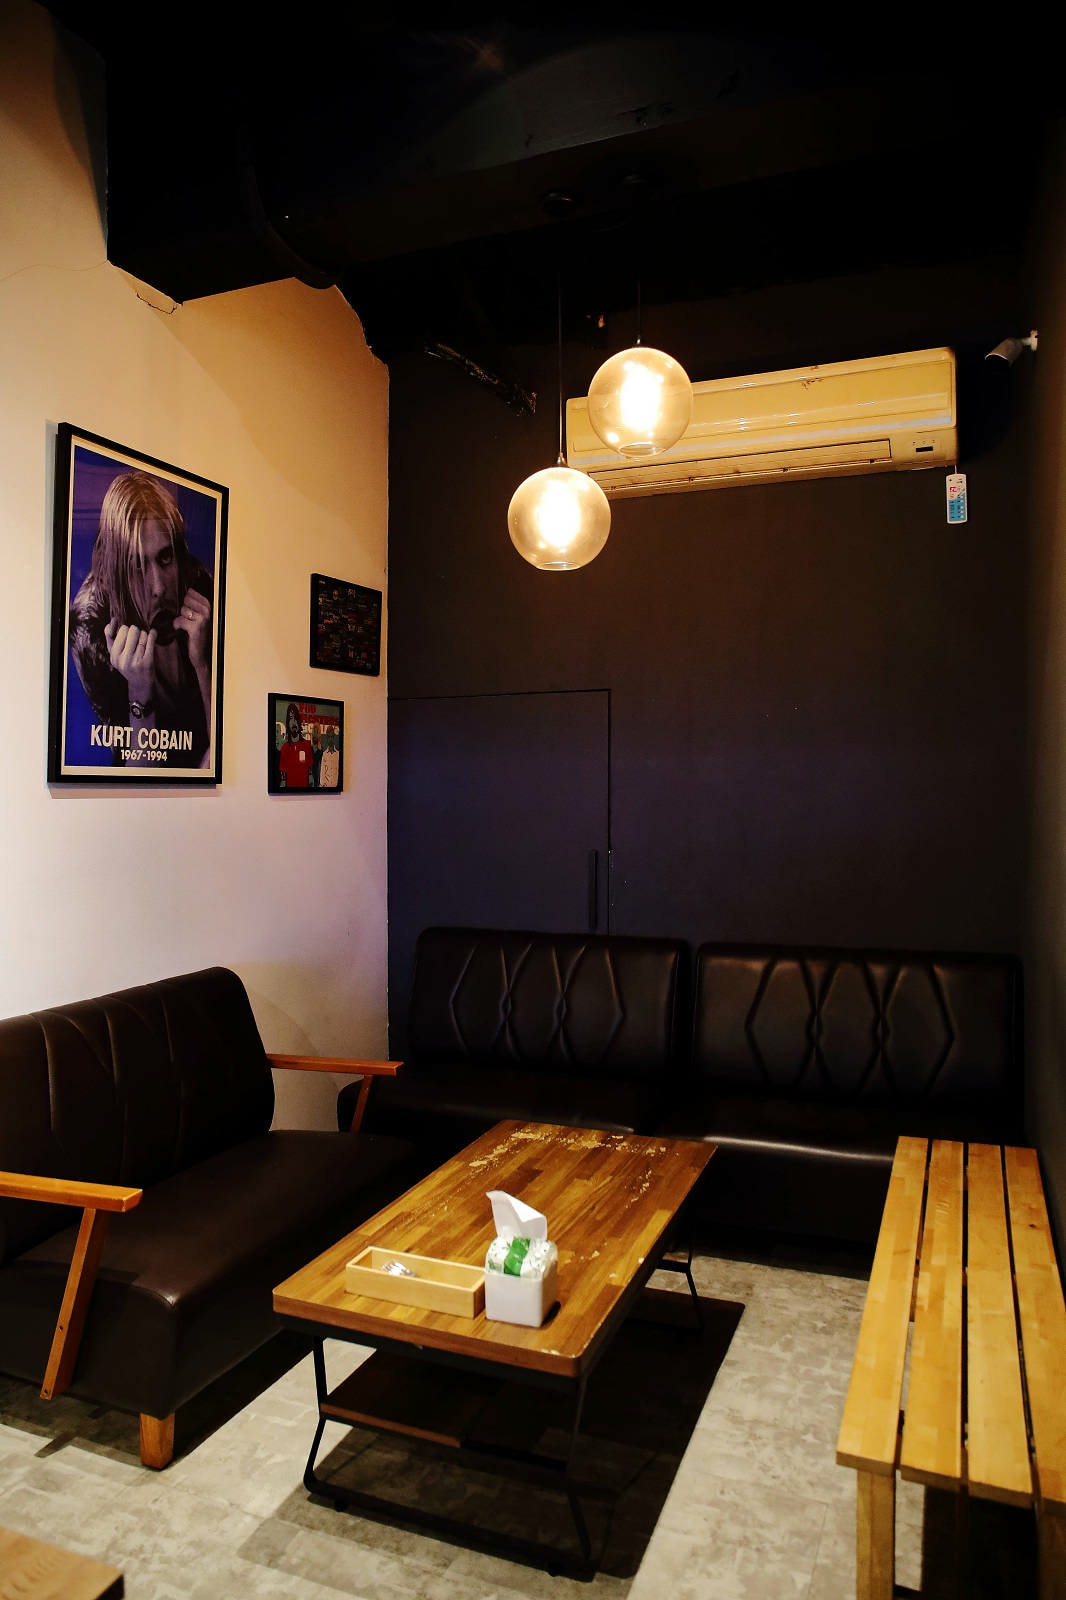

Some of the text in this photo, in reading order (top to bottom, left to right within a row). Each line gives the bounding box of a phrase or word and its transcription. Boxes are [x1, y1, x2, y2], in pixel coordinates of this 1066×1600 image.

[91, 725, 193, 750] KURT COBAIN
[121, 750, 167, 761] 1967-1994
